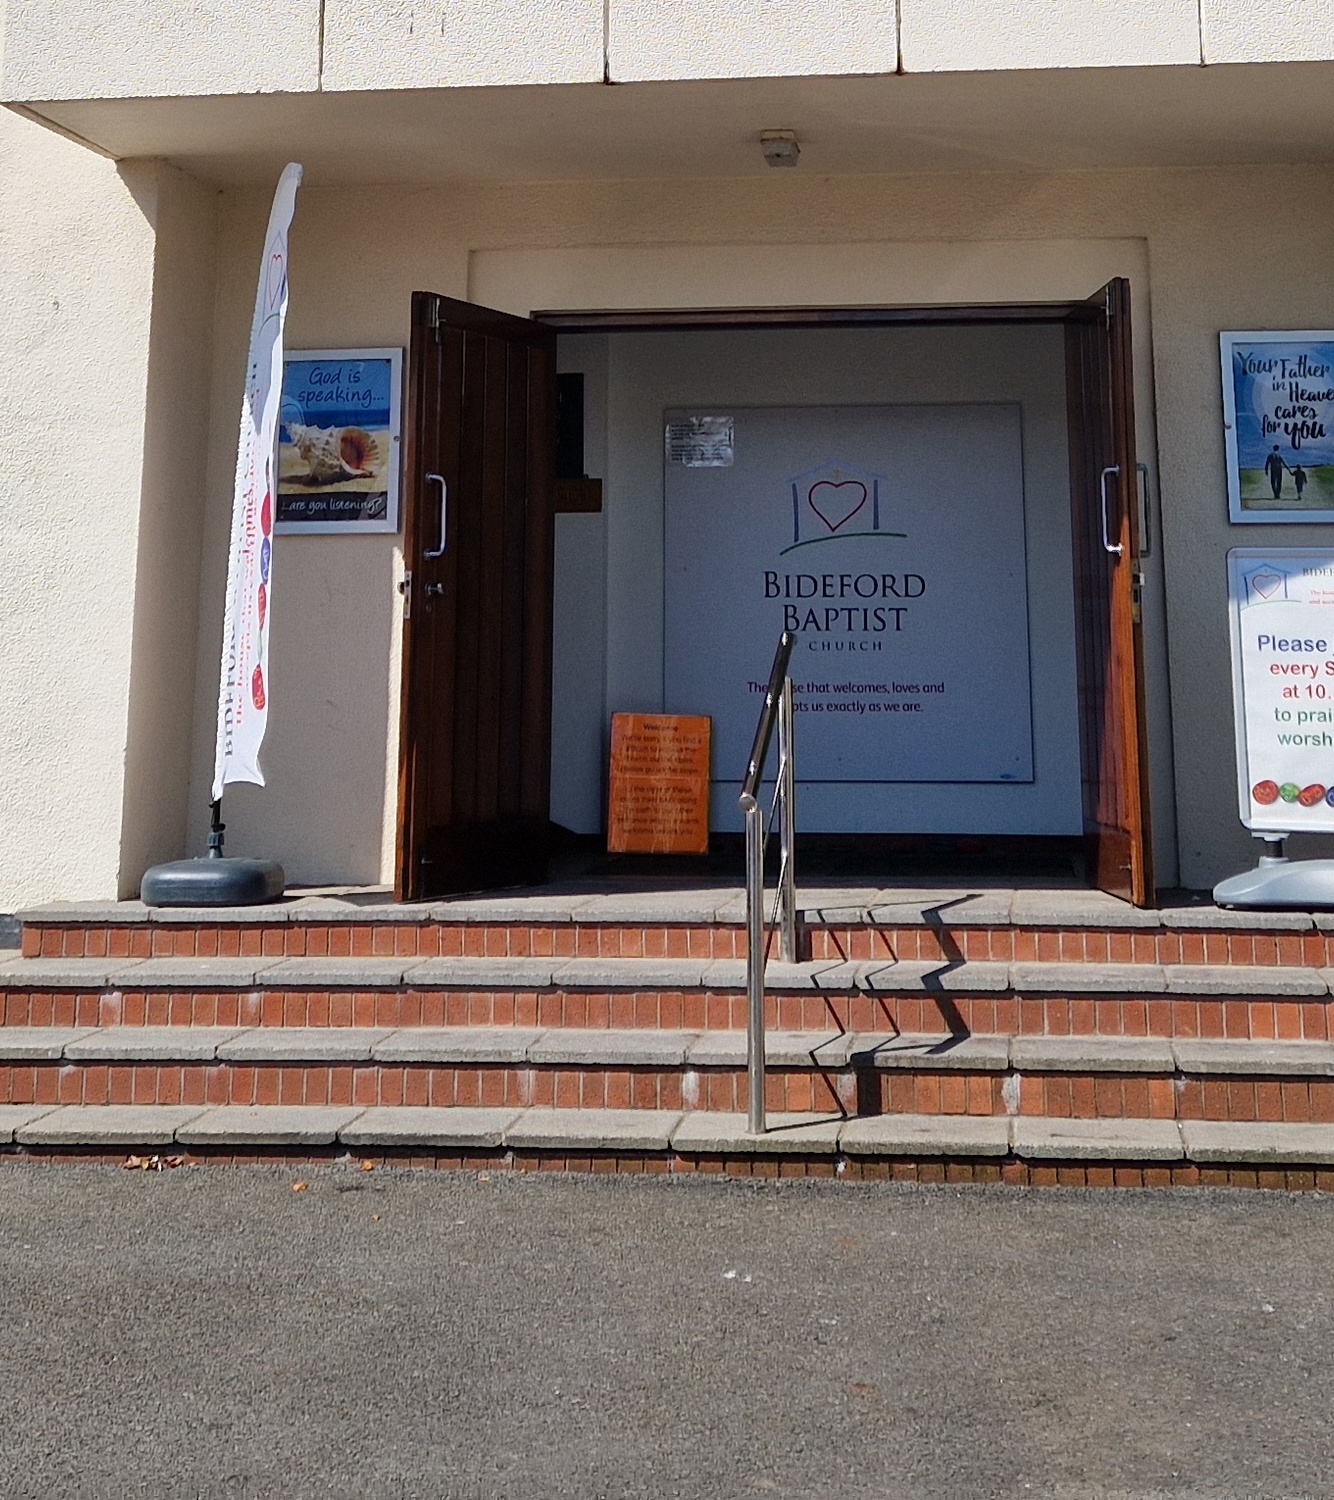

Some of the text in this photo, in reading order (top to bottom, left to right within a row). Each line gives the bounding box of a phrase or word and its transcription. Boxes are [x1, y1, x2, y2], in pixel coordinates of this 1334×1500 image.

[1236, 352, 1330, 380] Your Father
[309, 367, 361, 386] God is
[1272, 375, 1287, 392] in
[298, 385, 385, 409] speaking...
[1274, 405, 1318, 420] cares
[1262, 414, 1327, 451] for you
[308, 501, 328, 514] you
[330, 498, 382, 514] listening?
[763, 570, 927, 599] BIDEFORD
[782, 604, 909, 632] BAPTIST
[808, 640, 883, 652] CHURCH
[1257, 634, 1328, 654] Please
[1269, 663, 1319, 678] every
[807, 682, 830, 693] that
[833, 682, 890, 694] welcomes,
[892, 682, 920, 693] loves
[923, 682, 944, 693] and
[1282, 684, 1299, 699] at
[812, 703, 823, 712] us
[826, 701, 866, 715] exactly
[868, 703, 881, 712] as
[883, 703, 900, 712] we
[902, 703, 923, 712] are.
[1274, 707, 1292, 722] to
